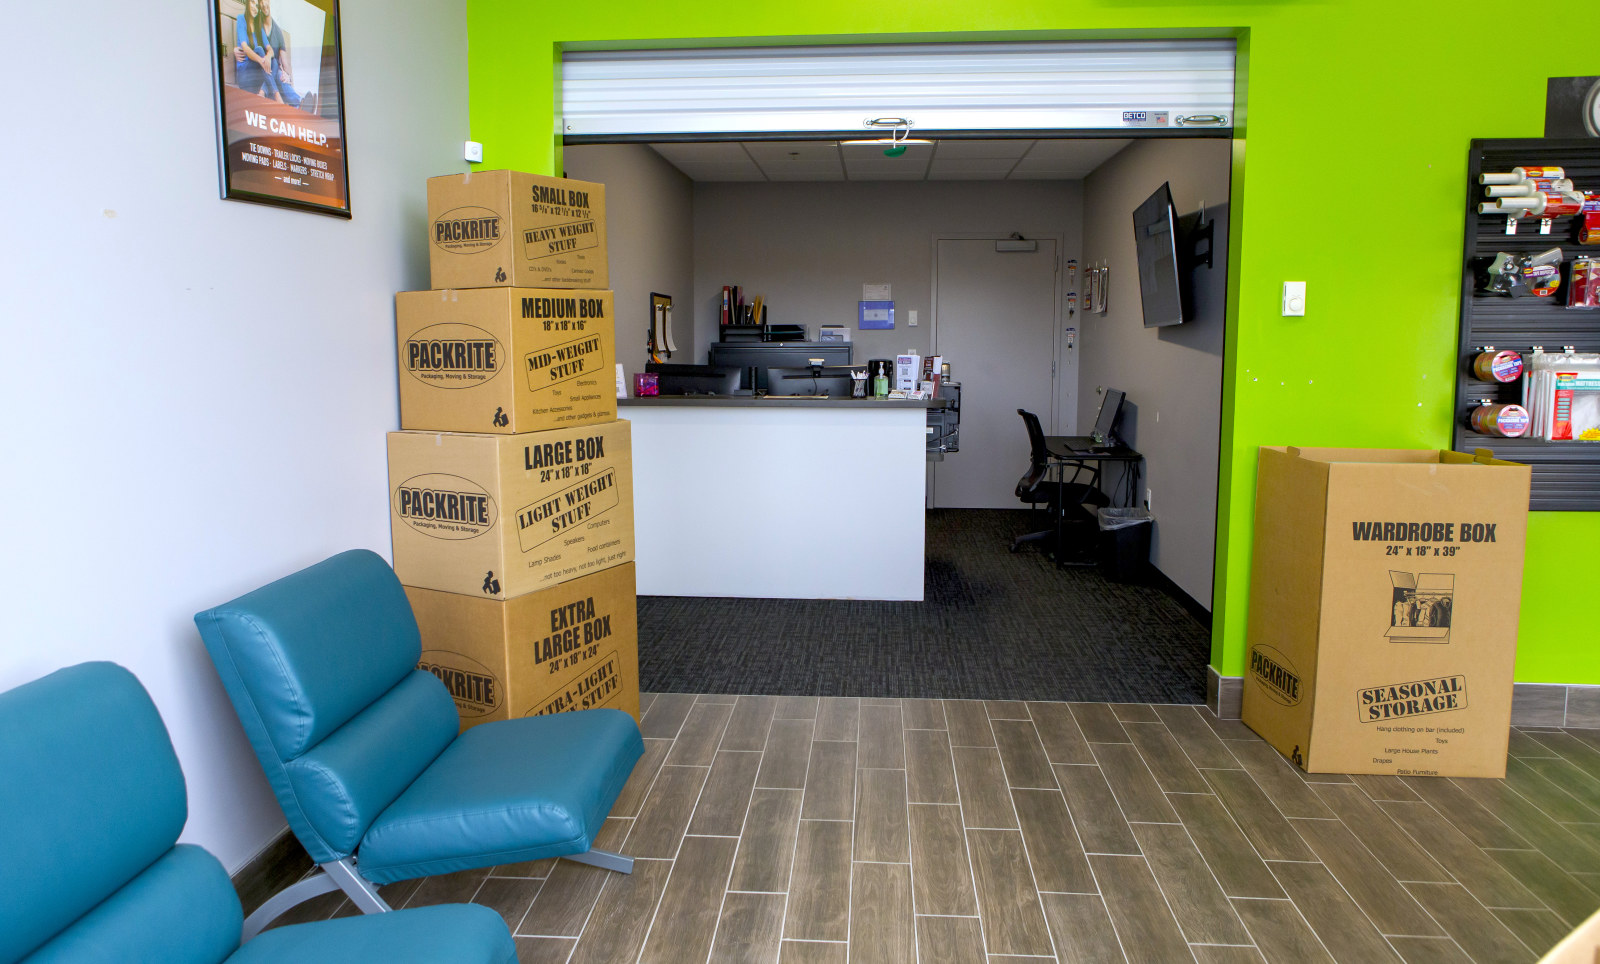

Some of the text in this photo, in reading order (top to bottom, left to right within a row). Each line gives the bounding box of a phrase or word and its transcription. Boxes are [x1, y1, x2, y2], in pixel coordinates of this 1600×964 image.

[245, 110, 328, 148] WE CAN HELP.
[242, 152, 258, 163] MOVING
[273, 160, 287, 170] LABELS
[532, 185, 589, 208] SMALL BOX
[532, 204, 538, 213] 16
[555, 207, 560, 215] 12
[576, 209, 581, 217] 12
[436, 218, 499, 241] PACKRITE
[526, 222, 595, 244] HEAVY WEIGHT
[549, 238, 577, 253] STUFF
[522, 298, 604, 318] MEDIUM BOX
[543, 320, 586, 331] 18" x 18" x 16"
[409, 342, 495, 370] PACKRITE
[528, 338, 599, 371] MID-WEIGHT
[550, 359, 584, 381] STUFF
[577, 412, 592, 420] gadgets
[524, 436, 604, 470] LARGE BOX
[540, 462, 592, 483] 24" x 18" x 18"
[400, 488, 488, 524] PACKRITE
[519, 472, 614, 530] LIGHT WEIGHT
[413, 521, 437, 529] Packaging,
[551, 502, 591, 533] STUFF
[587, 520, 610, 530] Computers
[564, 536, 584, 546] Speakers
[1352, 522, 1496, 542] WARDROBE BOX
[599, 539, 620, 550] containers
[1386, 546, 1460, 556] 24" x 18" x 39"
[529, 554, 561, 568] Lamp Shades
[563, 566, 577, 574] heavy,
[607, 555, 615, 563] just
[617, 551, 626, 560] right
[551, 597, 595, 632] EXTRA
[534, 615, 612, 664] LARGE BOX
[550, 644, 599, 674] 24" x 18" x 24"
[421, 664, 494, 705] KRITE
[1251, 650, 1298, 700] PACKRITE
[582, 674, 618, 710] STUFF
[1362, 678, 1461, 705] SEASONAL
[1369, 694, 1458, 720] STORAGE
